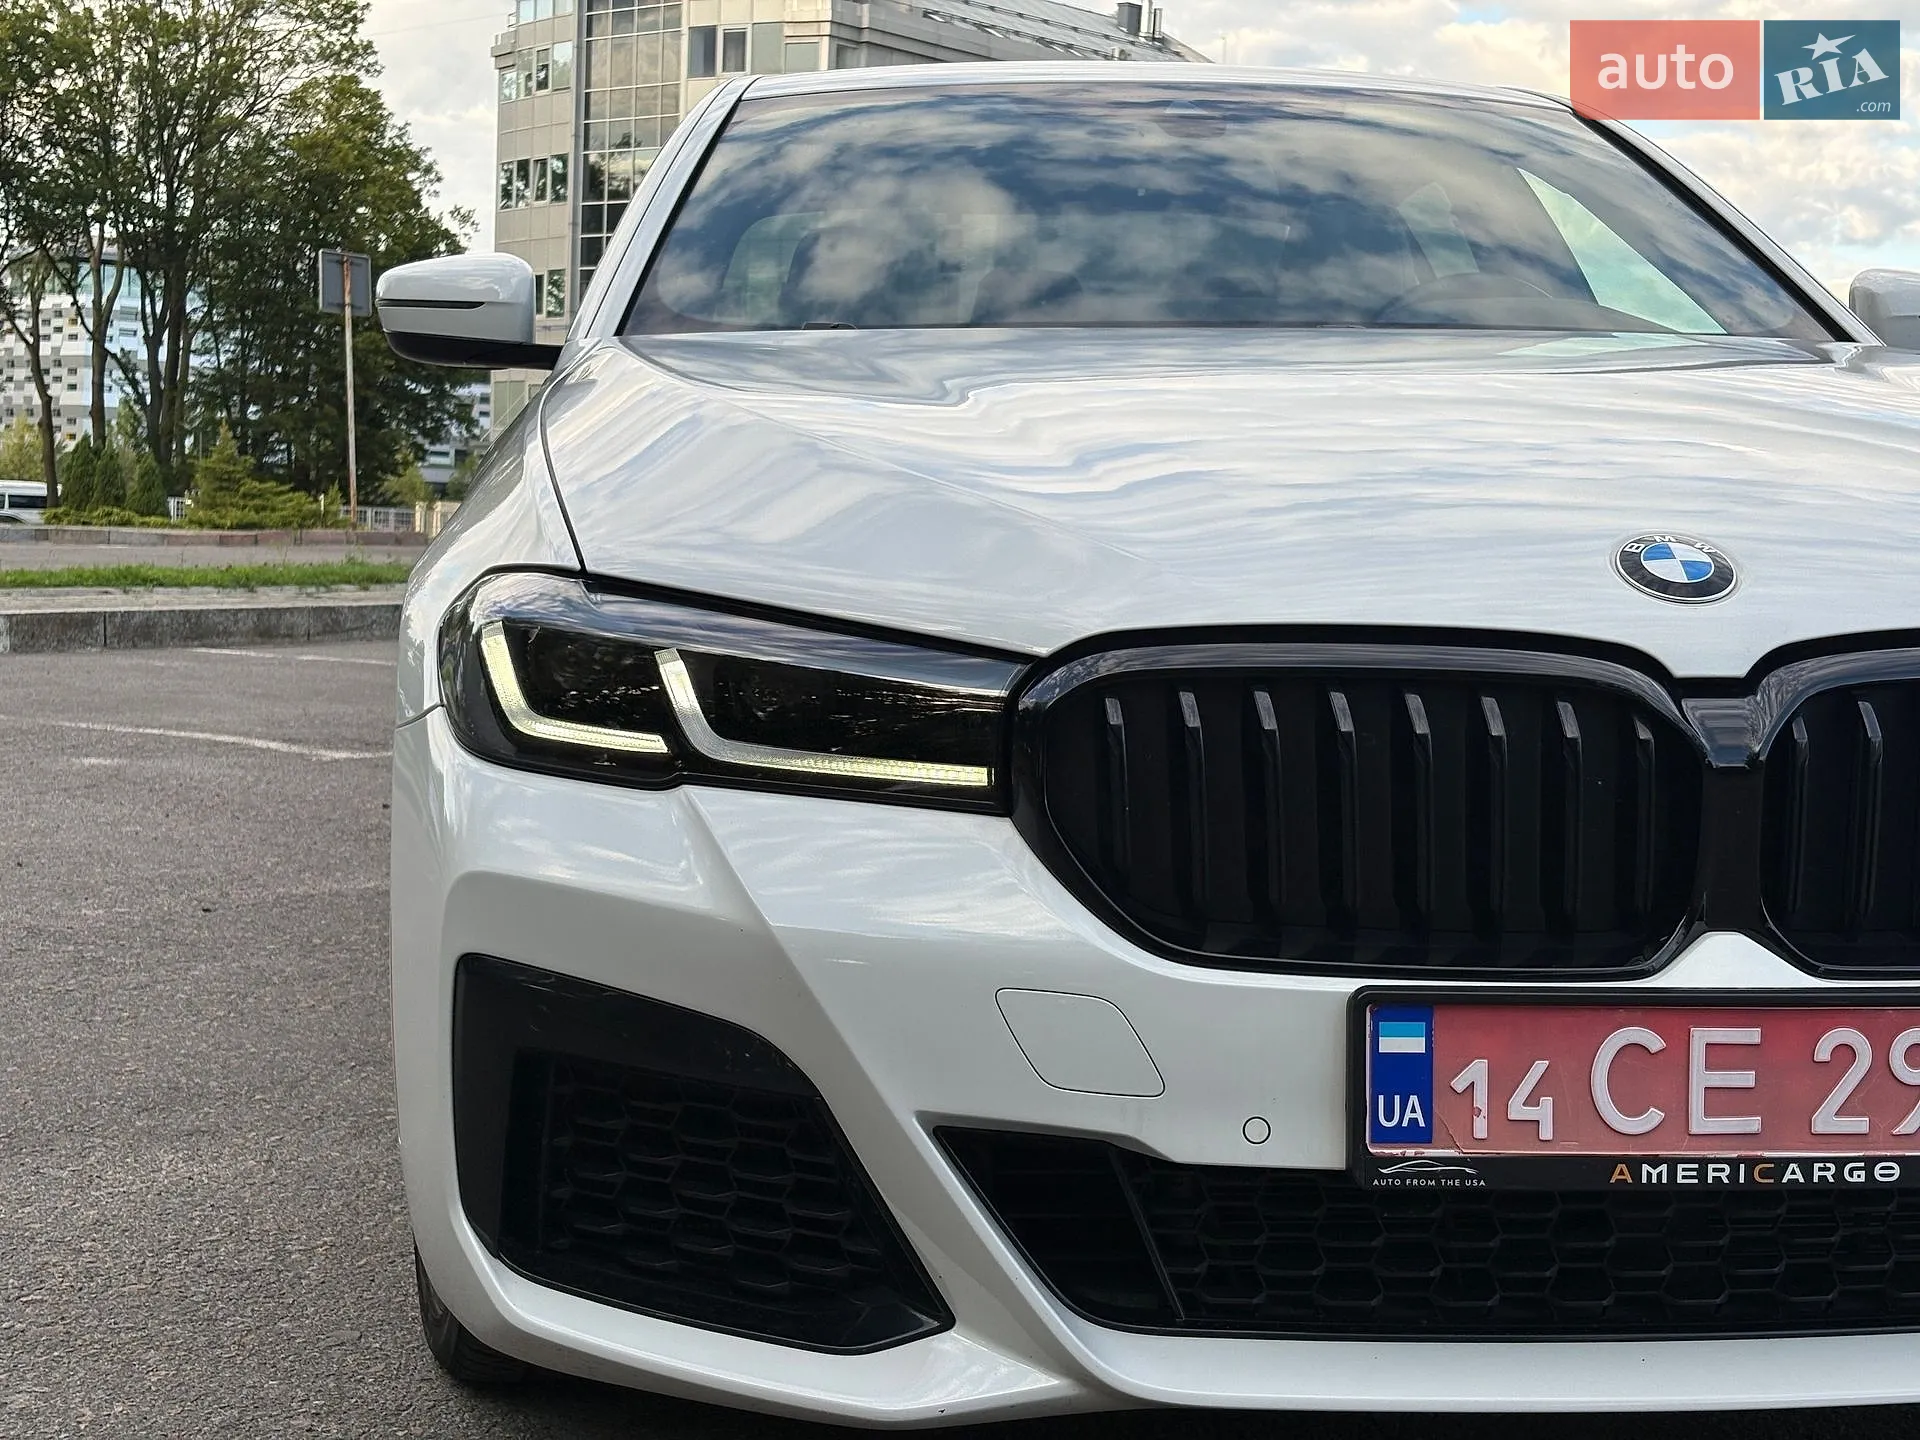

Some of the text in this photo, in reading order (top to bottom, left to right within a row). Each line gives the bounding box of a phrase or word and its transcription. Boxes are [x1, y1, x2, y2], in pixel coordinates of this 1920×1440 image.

[1623, 535, 1716, 553] BMW
[1450, 1058, 1554, 1141] 14
[1590, 1026, 1763, 1135] CE
[1377, 1094, 1426, 1129] UA
[1372, 1178, 1486, 1187] AUTO FROM THE USA
[1610, 1162, 1901, 1185] AMERICARGO
